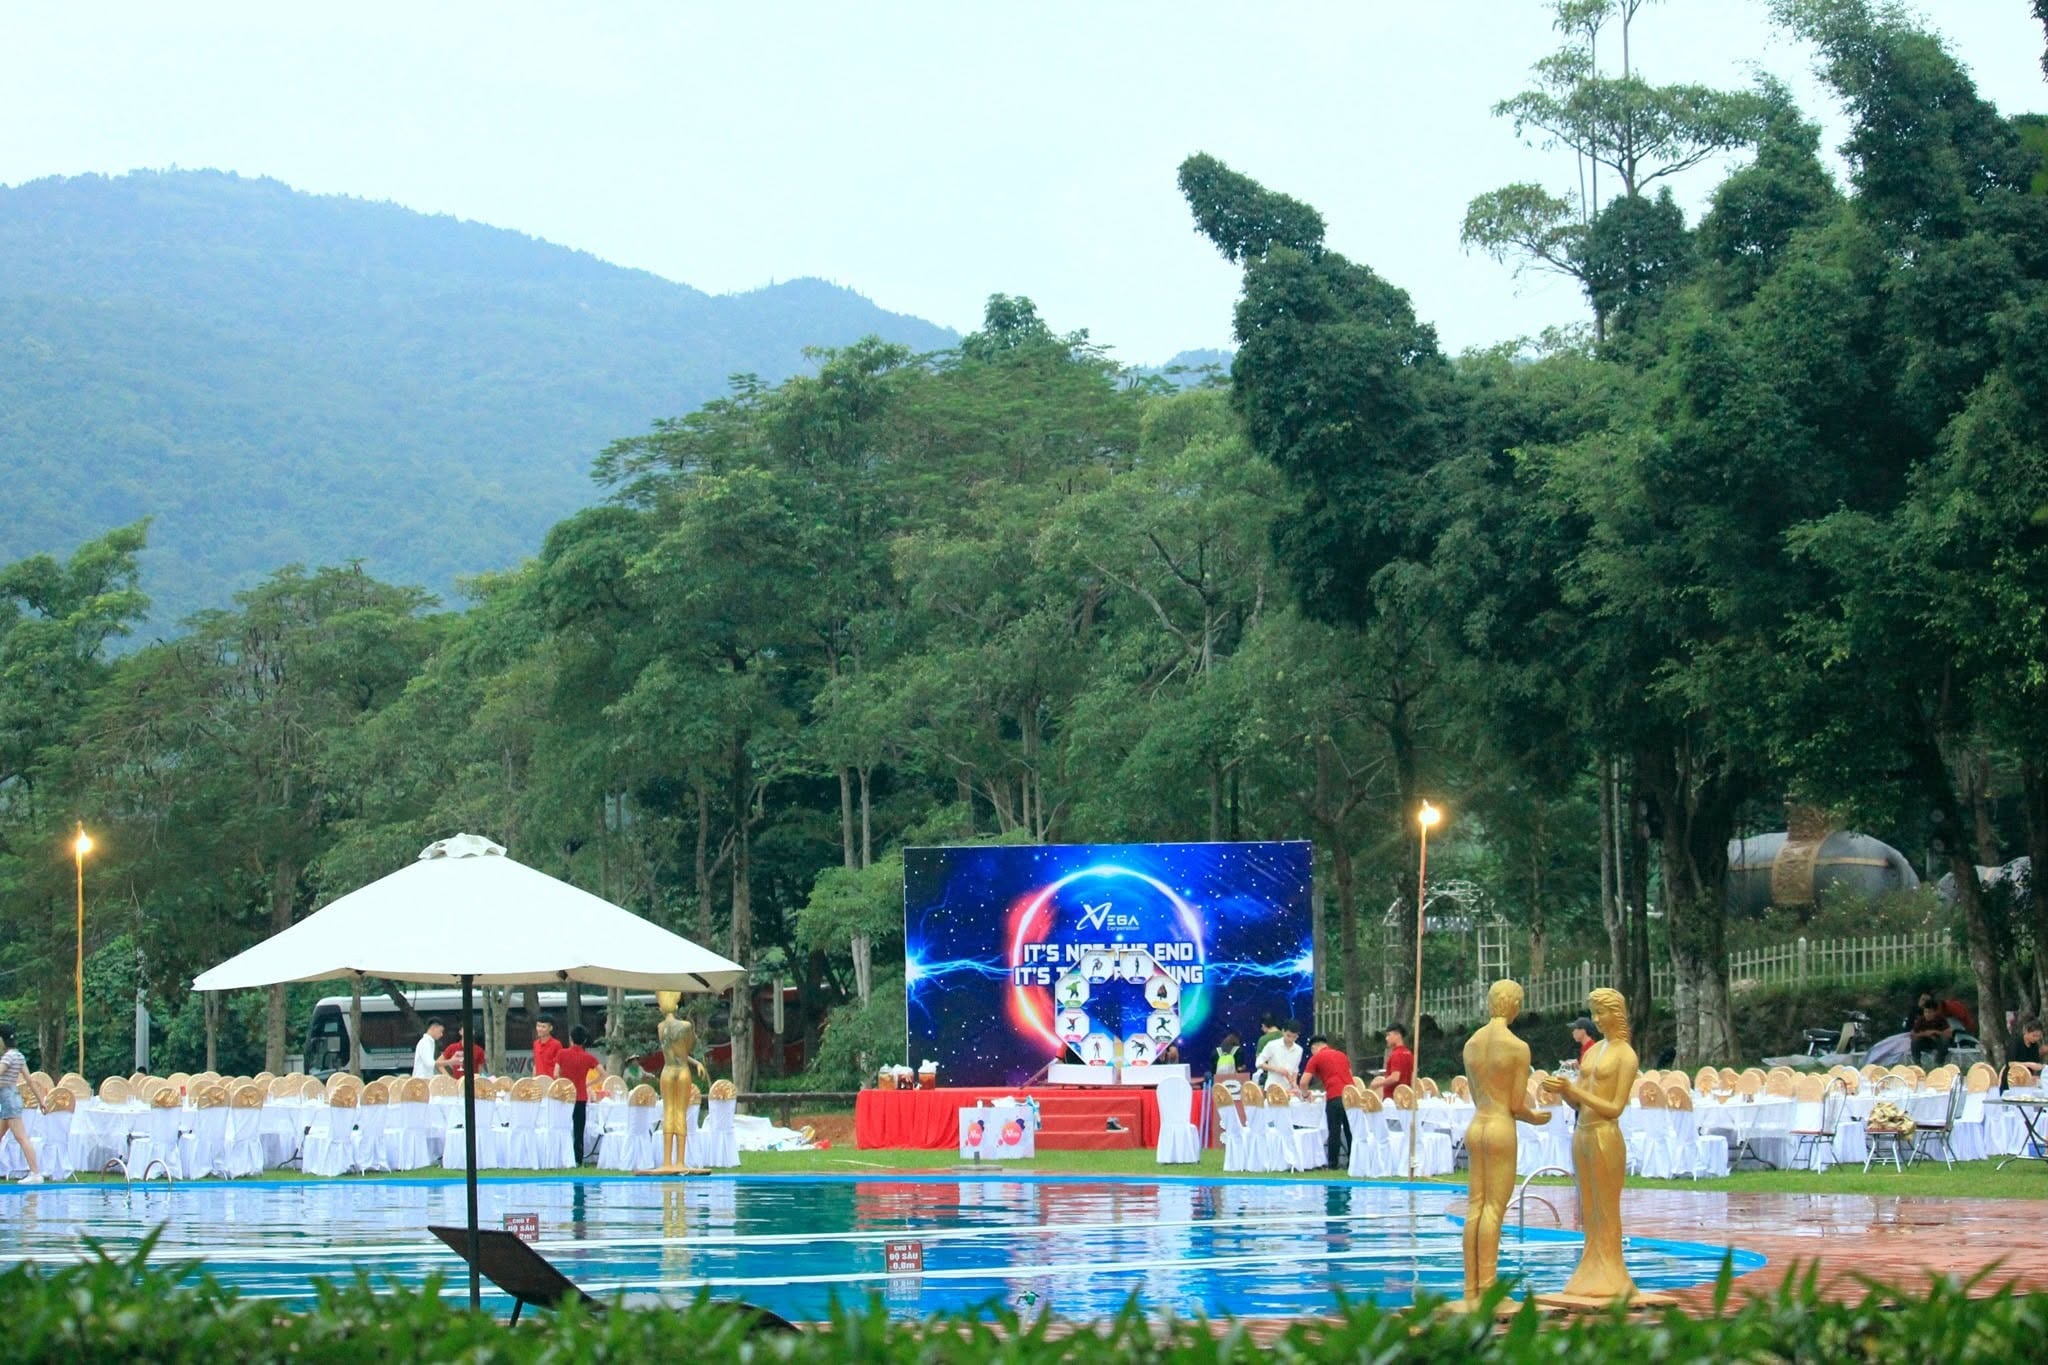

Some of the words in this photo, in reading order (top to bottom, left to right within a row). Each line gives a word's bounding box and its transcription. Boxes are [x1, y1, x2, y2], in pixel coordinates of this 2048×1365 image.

[1024, 944, 1060, 962] IT'S
[1154, 943, 1193, 961] END
[1015, 967, 1050, 985] IT'S
